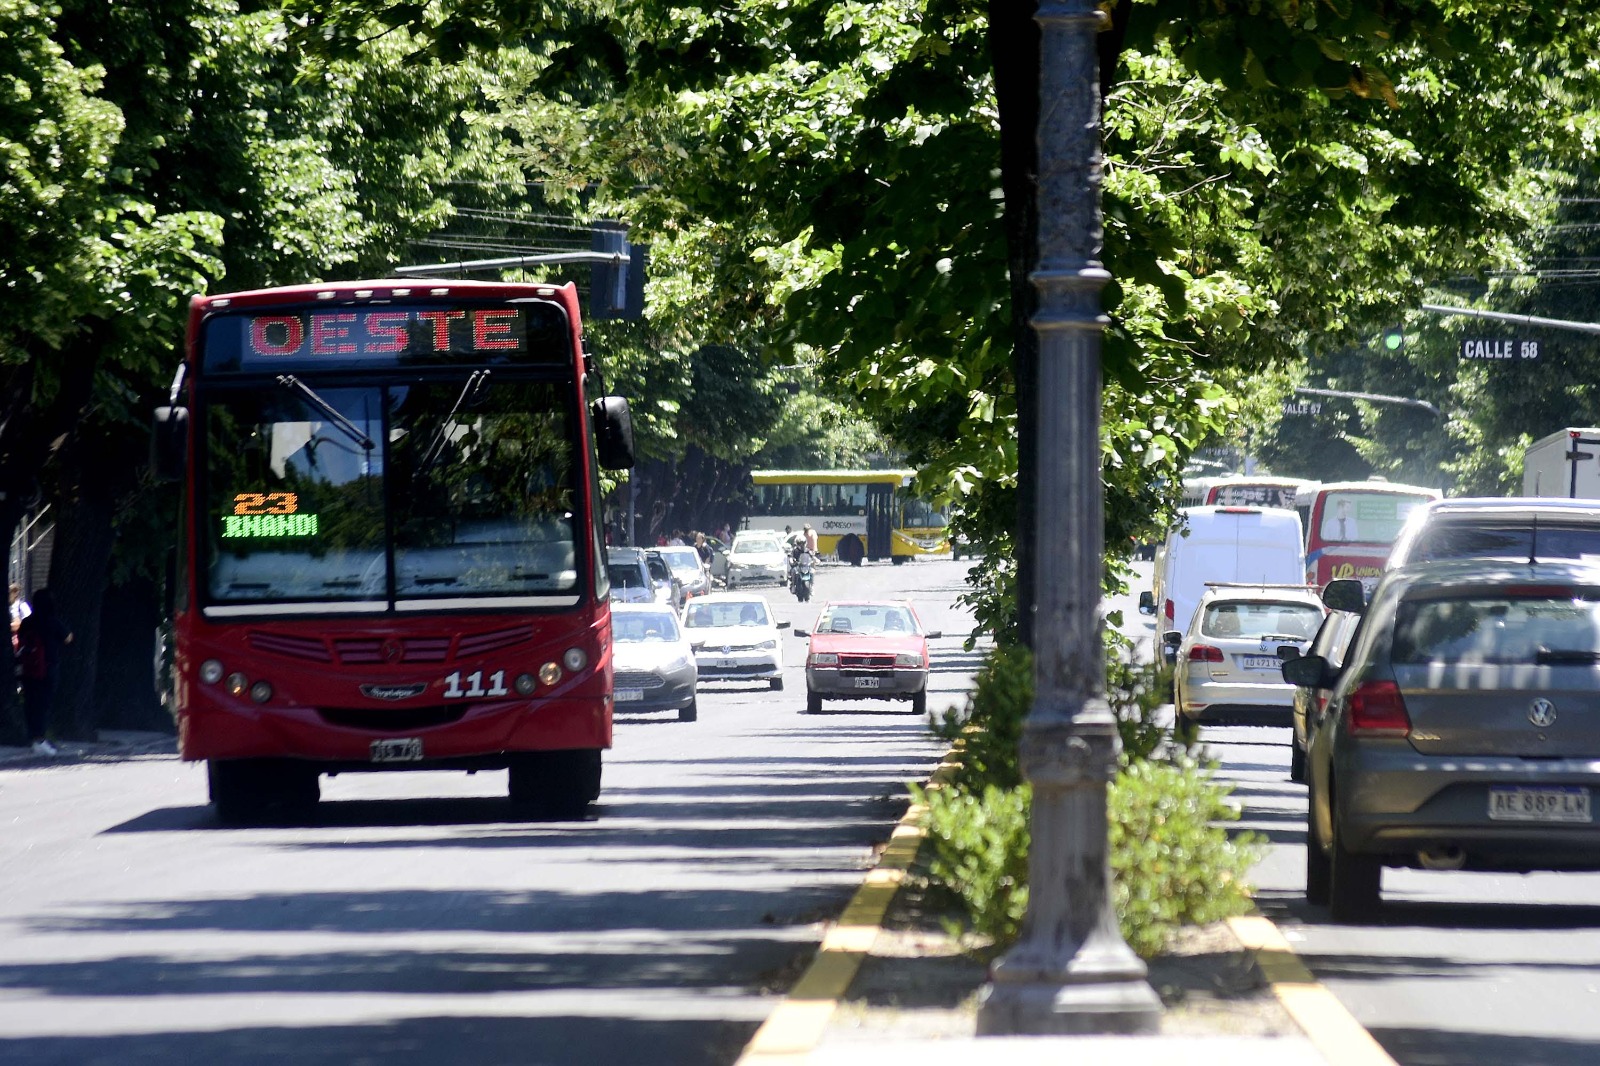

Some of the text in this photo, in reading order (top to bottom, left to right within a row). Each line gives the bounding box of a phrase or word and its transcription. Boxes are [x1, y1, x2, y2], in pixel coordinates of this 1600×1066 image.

[249, 309, 520, 355] OESTE
[1464, 340, 1539, 359] CALLE 58
[234, 492, 297, 515] 23
[442, 670, 508, 699] 111
[1496, 794, 1517, 811] AE
